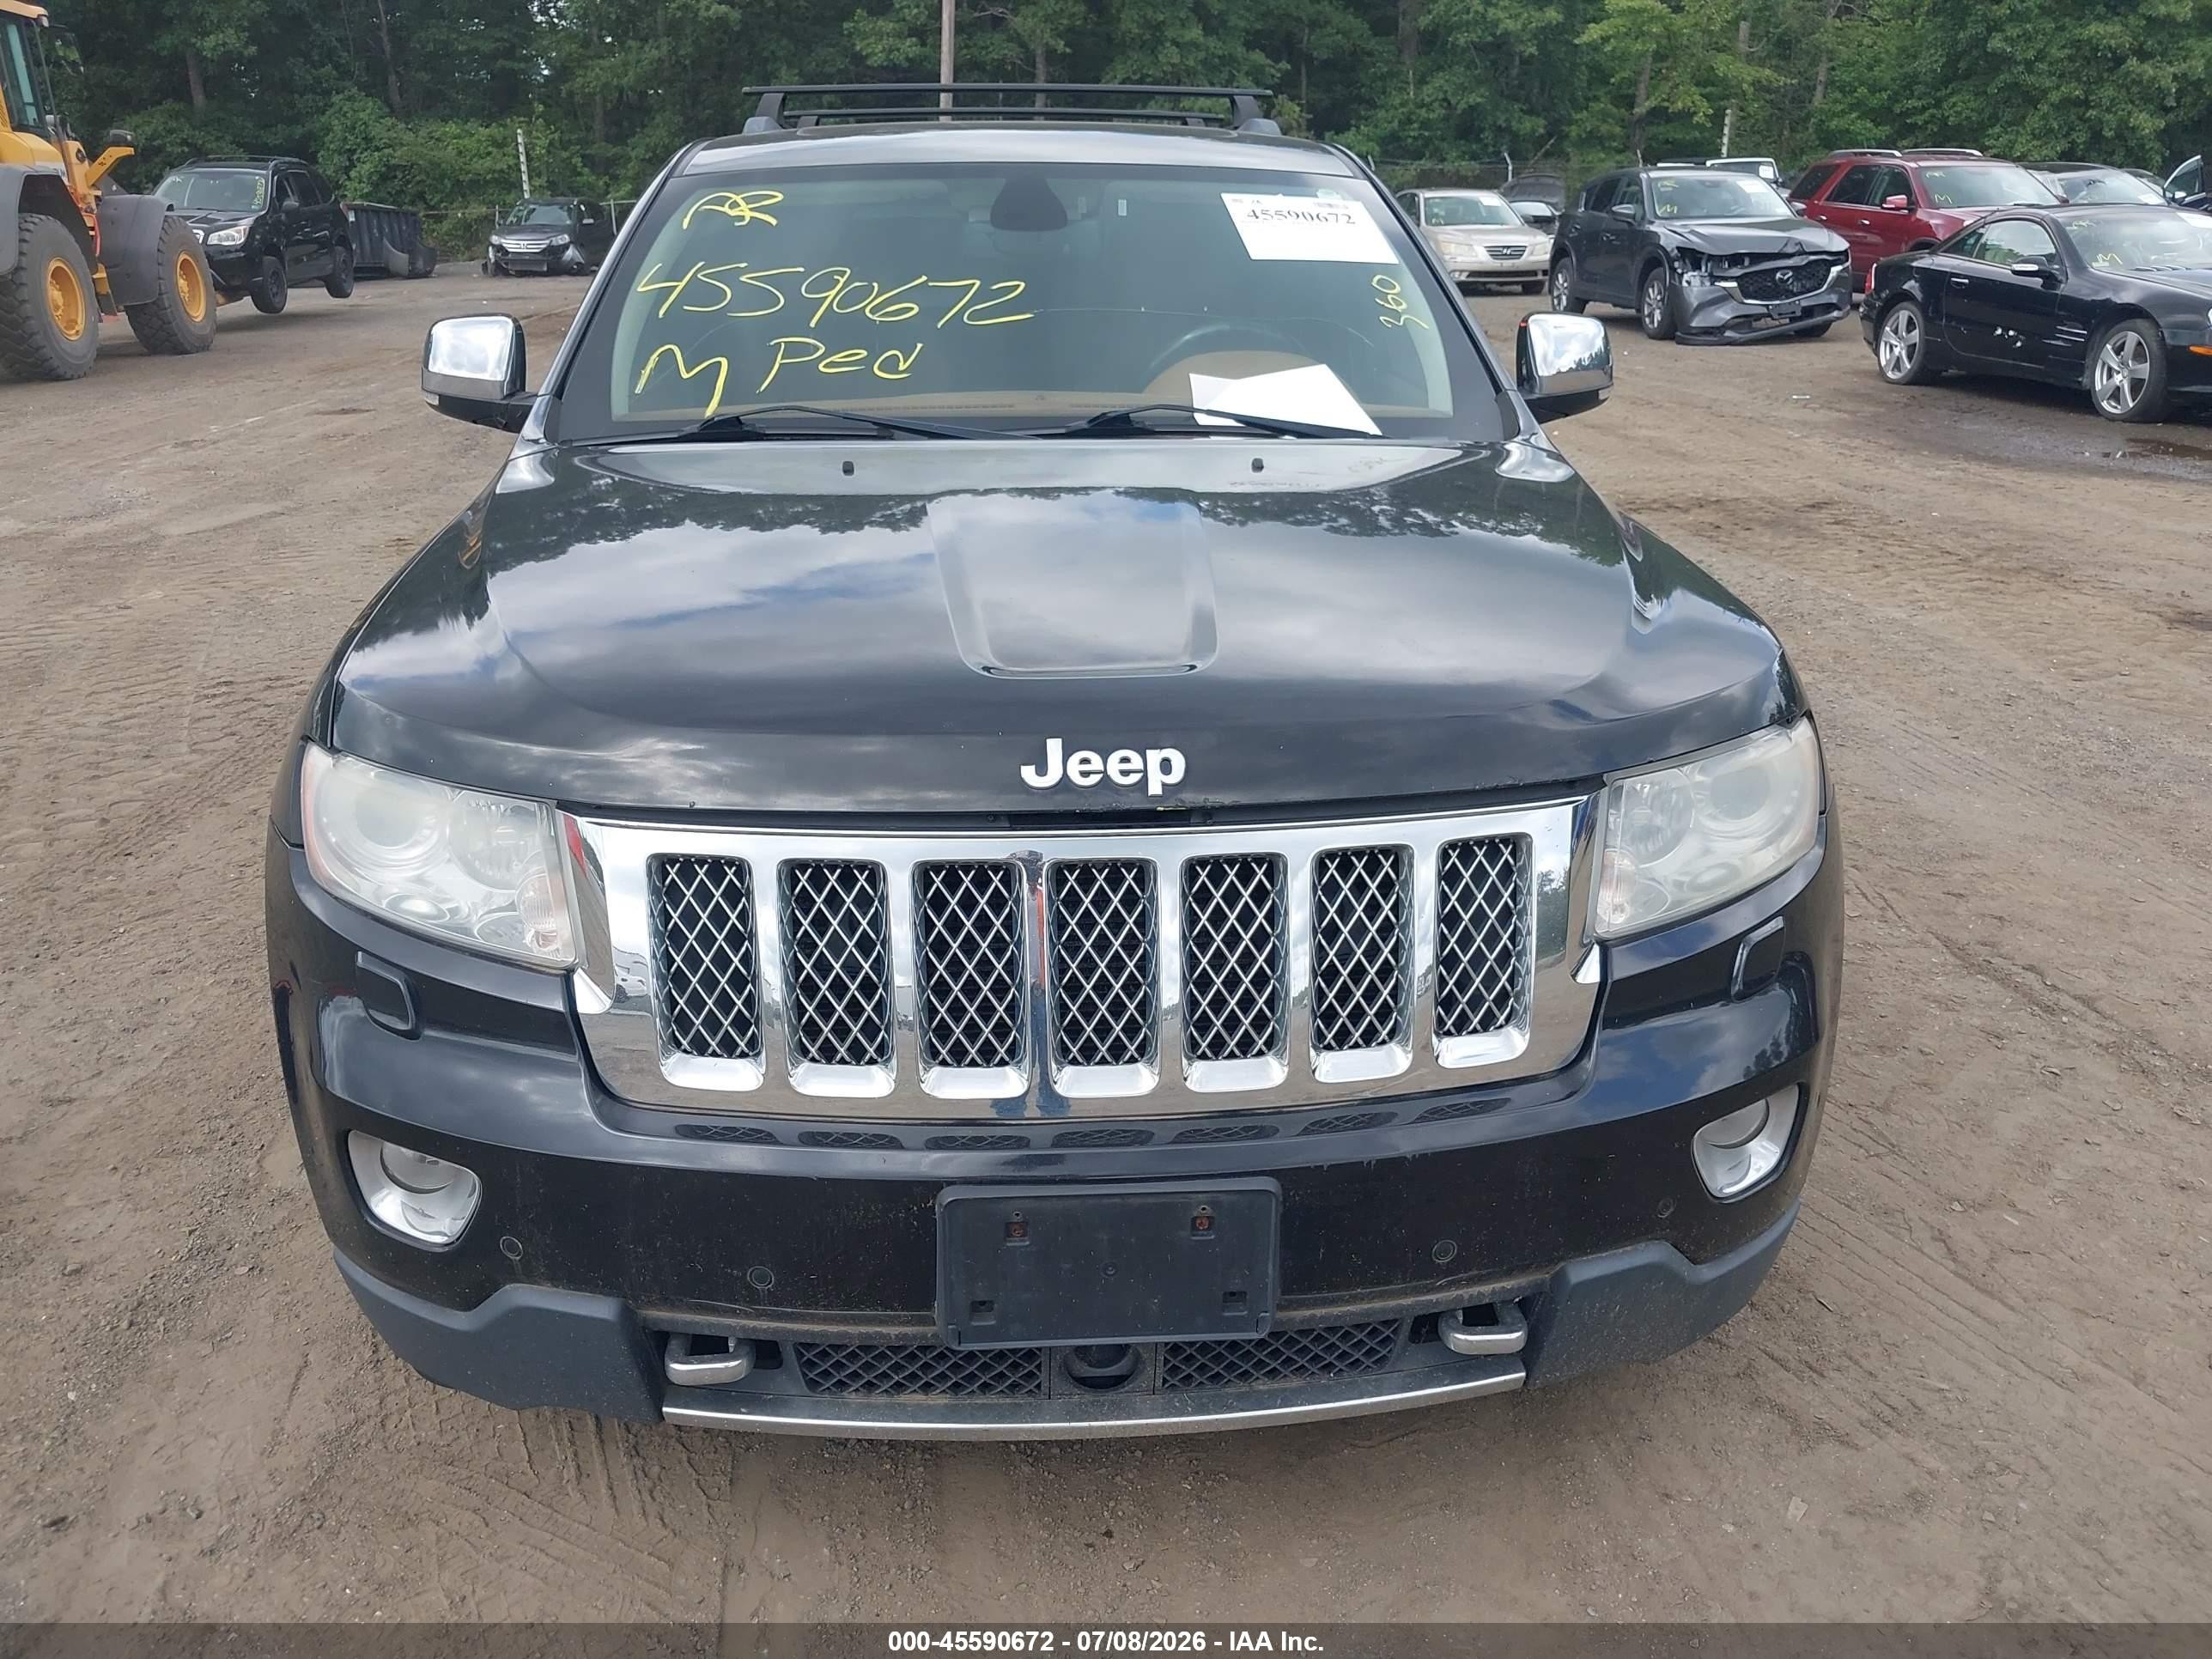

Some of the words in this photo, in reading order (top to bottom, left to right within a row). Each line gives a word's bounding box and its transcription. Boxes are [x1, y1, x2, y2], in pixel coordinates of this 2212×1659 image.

[1247, 209, 1356, 225] 45590672
[636, 261, 1035, 329] 45590672
[1371, 274, 1429, 330] 360
[1019, 738, 1187, 797] Jeep
